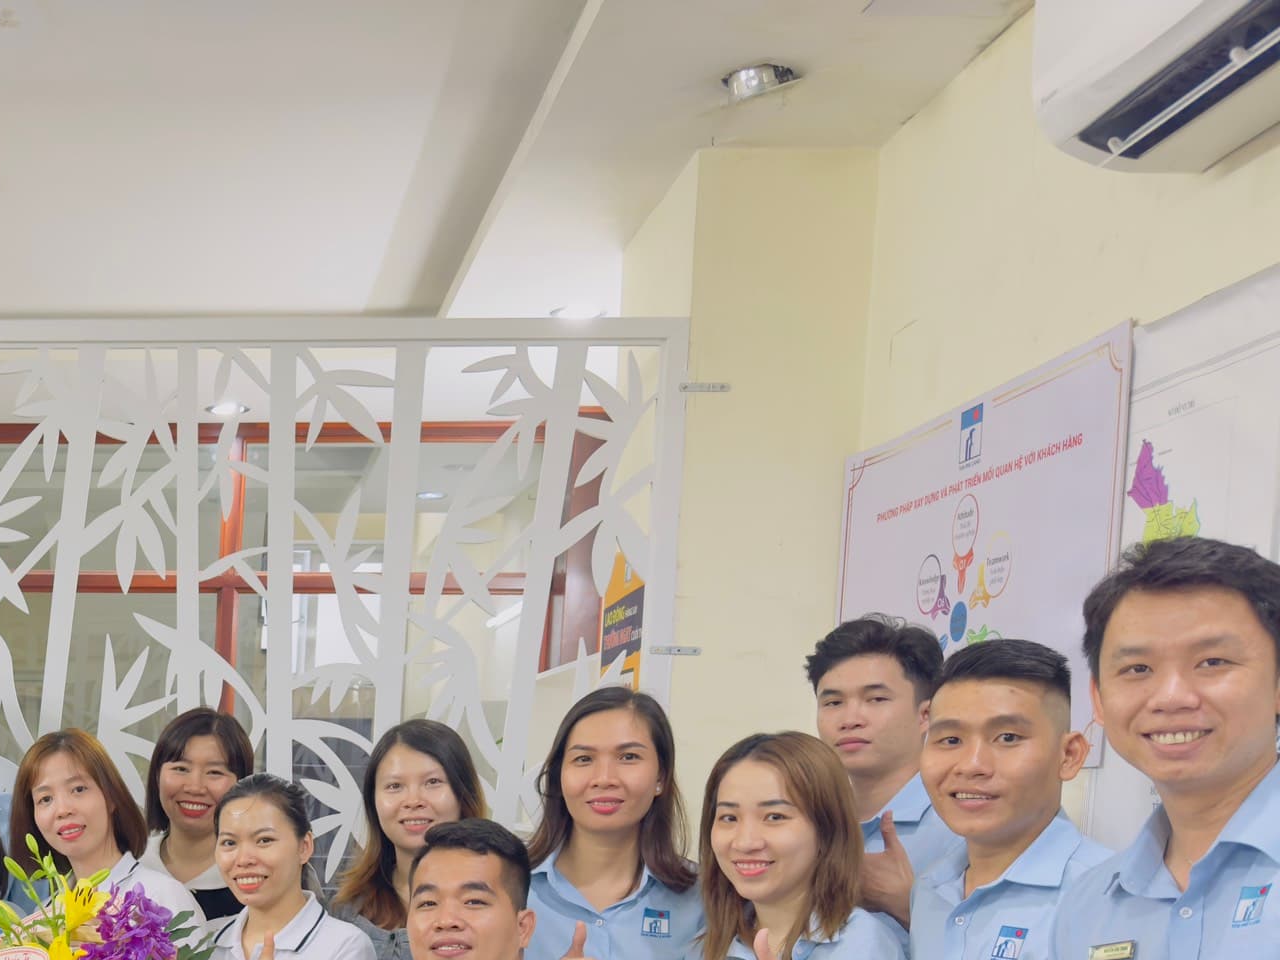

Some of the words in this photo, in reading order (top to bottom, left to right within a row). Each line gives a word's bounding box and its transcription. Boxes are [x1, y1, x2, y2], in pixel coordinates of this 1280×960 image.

[995, 461, 1013, 478] QUAN
[1037, 442, 1061, 462] KHÁCH
[1062, 433, 1083, 451] HÀNG
